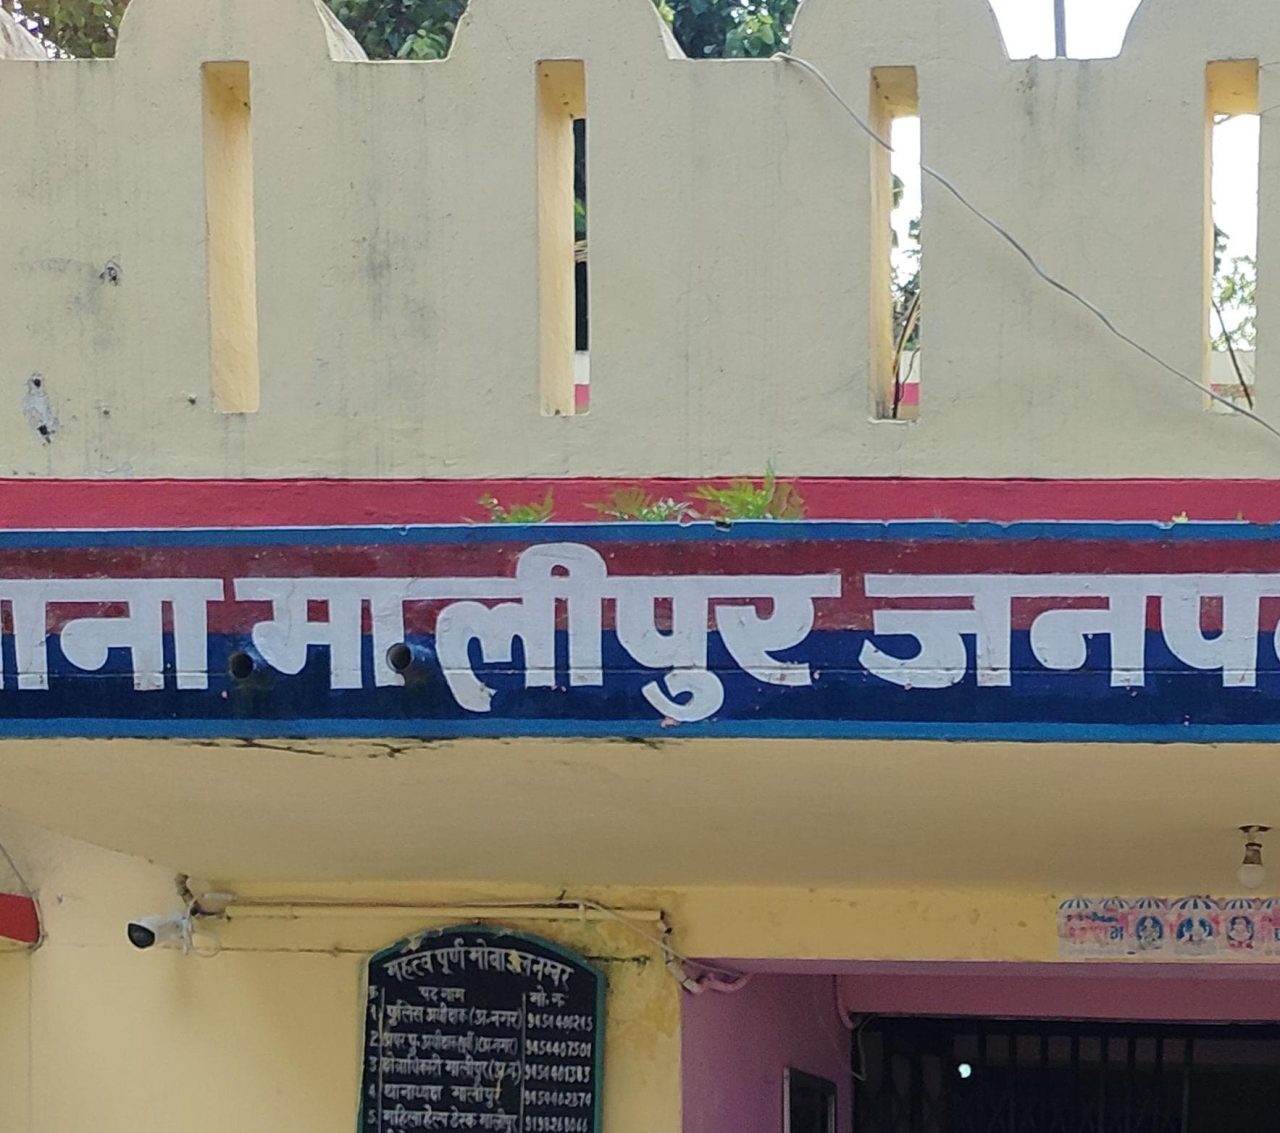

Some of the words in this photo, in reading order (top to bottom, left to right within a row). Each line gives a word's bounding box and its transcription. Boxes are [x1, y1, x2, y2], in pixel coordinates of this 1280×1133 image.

[0, 578, 223, 691] ाना
[233, 542, 842, 722] मालीपुर
[386, 1000, 424, 1027] पुलिस
[383, 1104, 422, 1128] महिला
